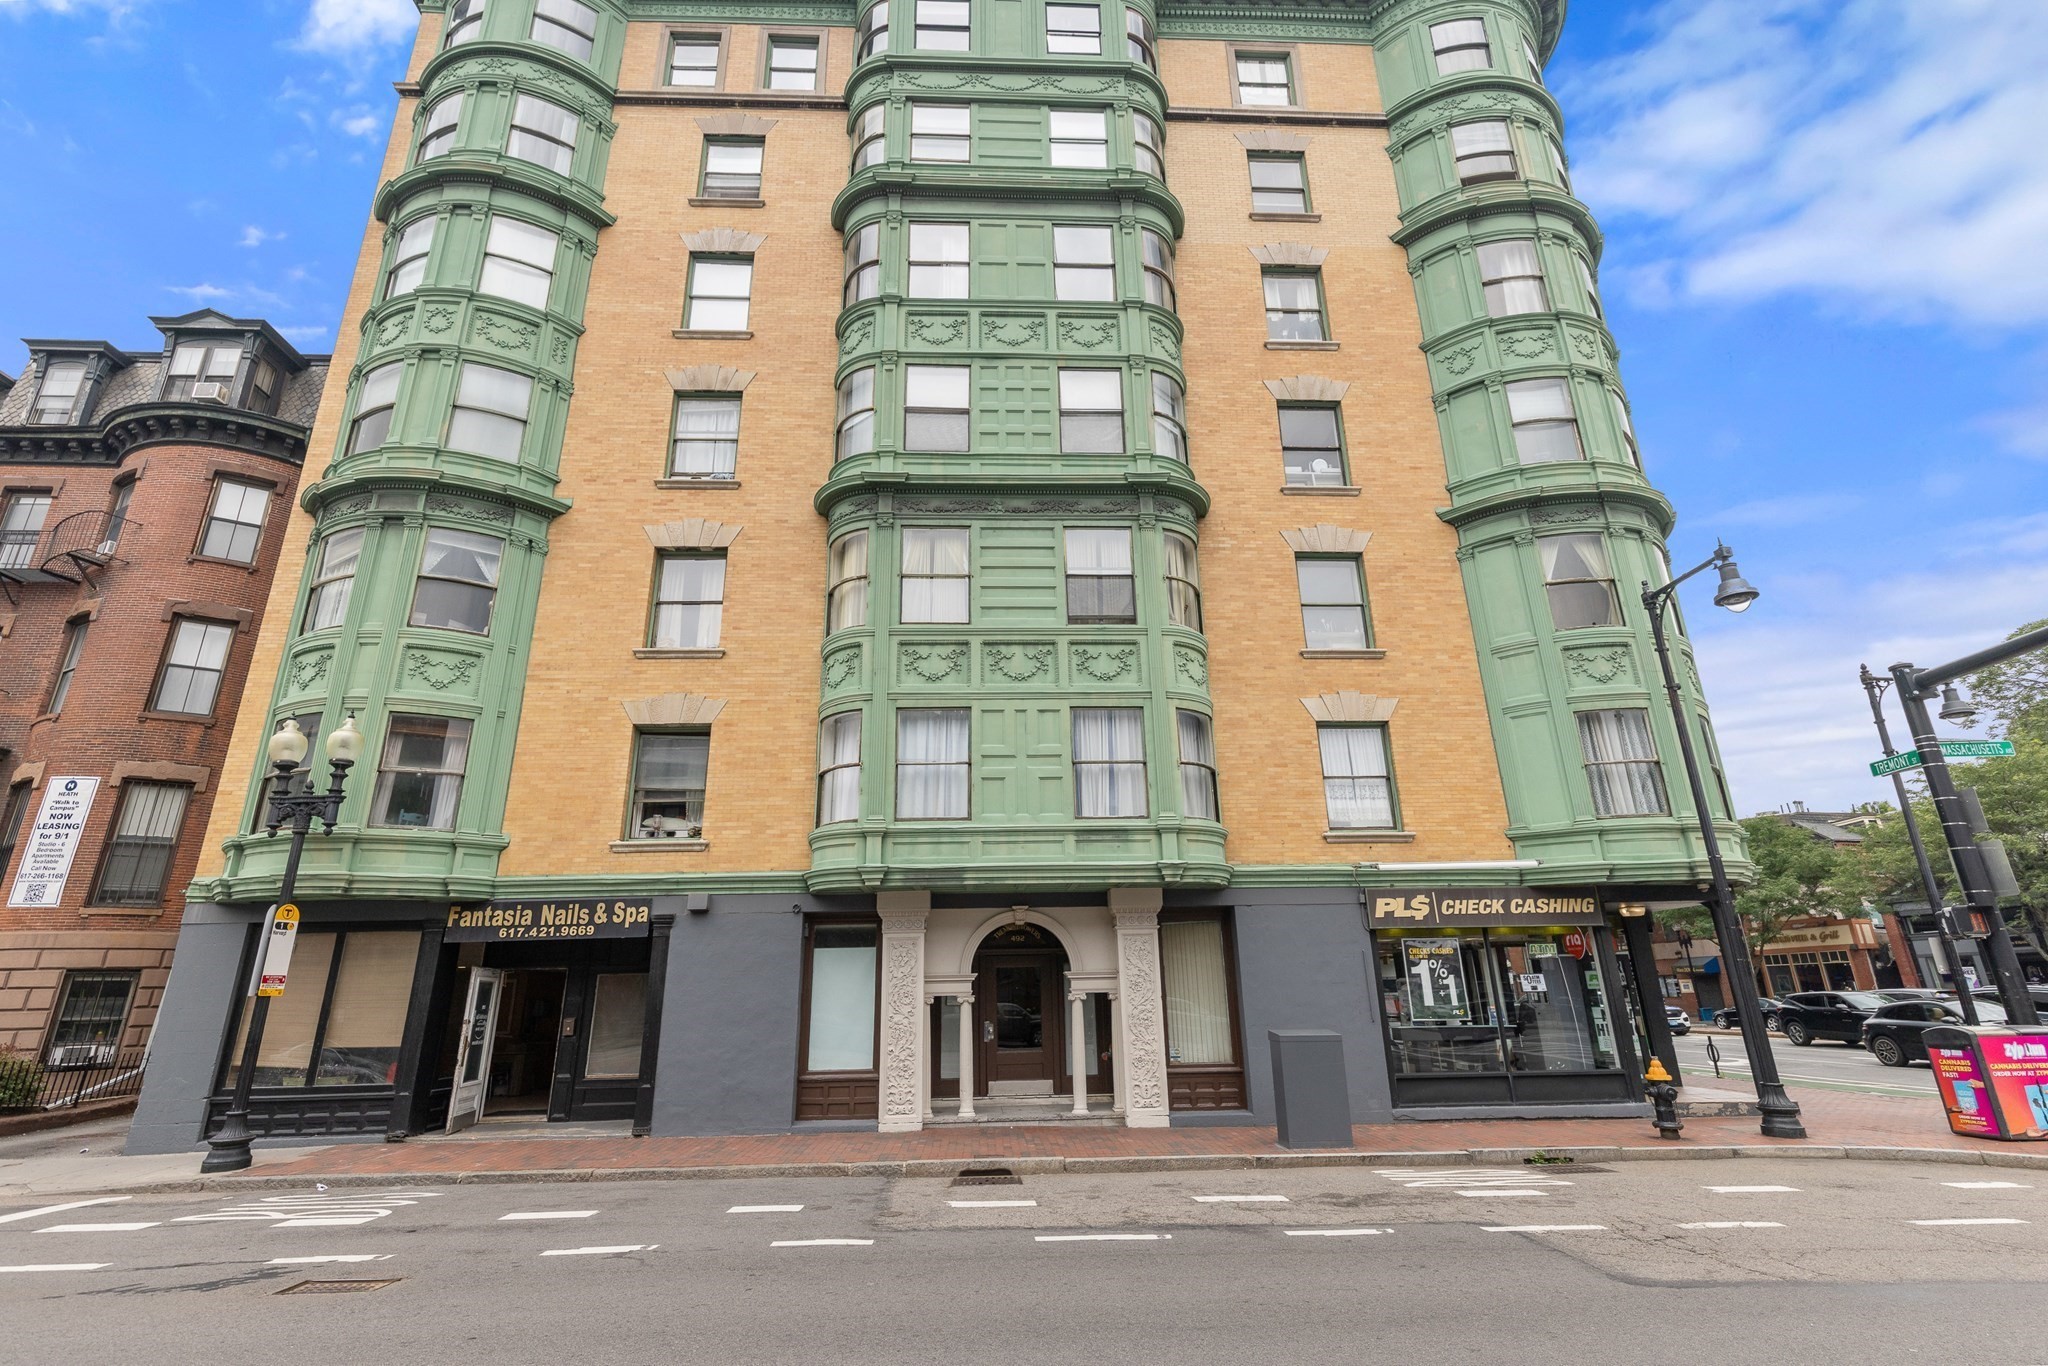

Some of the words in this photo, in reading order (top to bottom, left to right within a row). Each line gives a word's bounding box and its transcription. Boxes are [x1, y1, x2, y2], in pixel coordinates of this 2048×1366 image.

[1940, 744, 2003, 756] MASSACHUSETTS
[1874, 754, 1910, 774] TREMONT
[1375, 894, 1430, 921] PL$
[1441, 898, 1505, 914] CHECK
[1510, 898, 1595, 914] CASHING
[447, 904, 532, 928] Fantasia
[540, 904, 590, 926] Nails
[594, 902, 608, 924] &
[612, 902, 648, 928] Spa
[498, 925, 595, 938] 617.421.9669
[1819, 930, 1840, 942] Grill
[1566, 934, 1581, 946] ria
[1530, 944, 1555, 954] ATM
